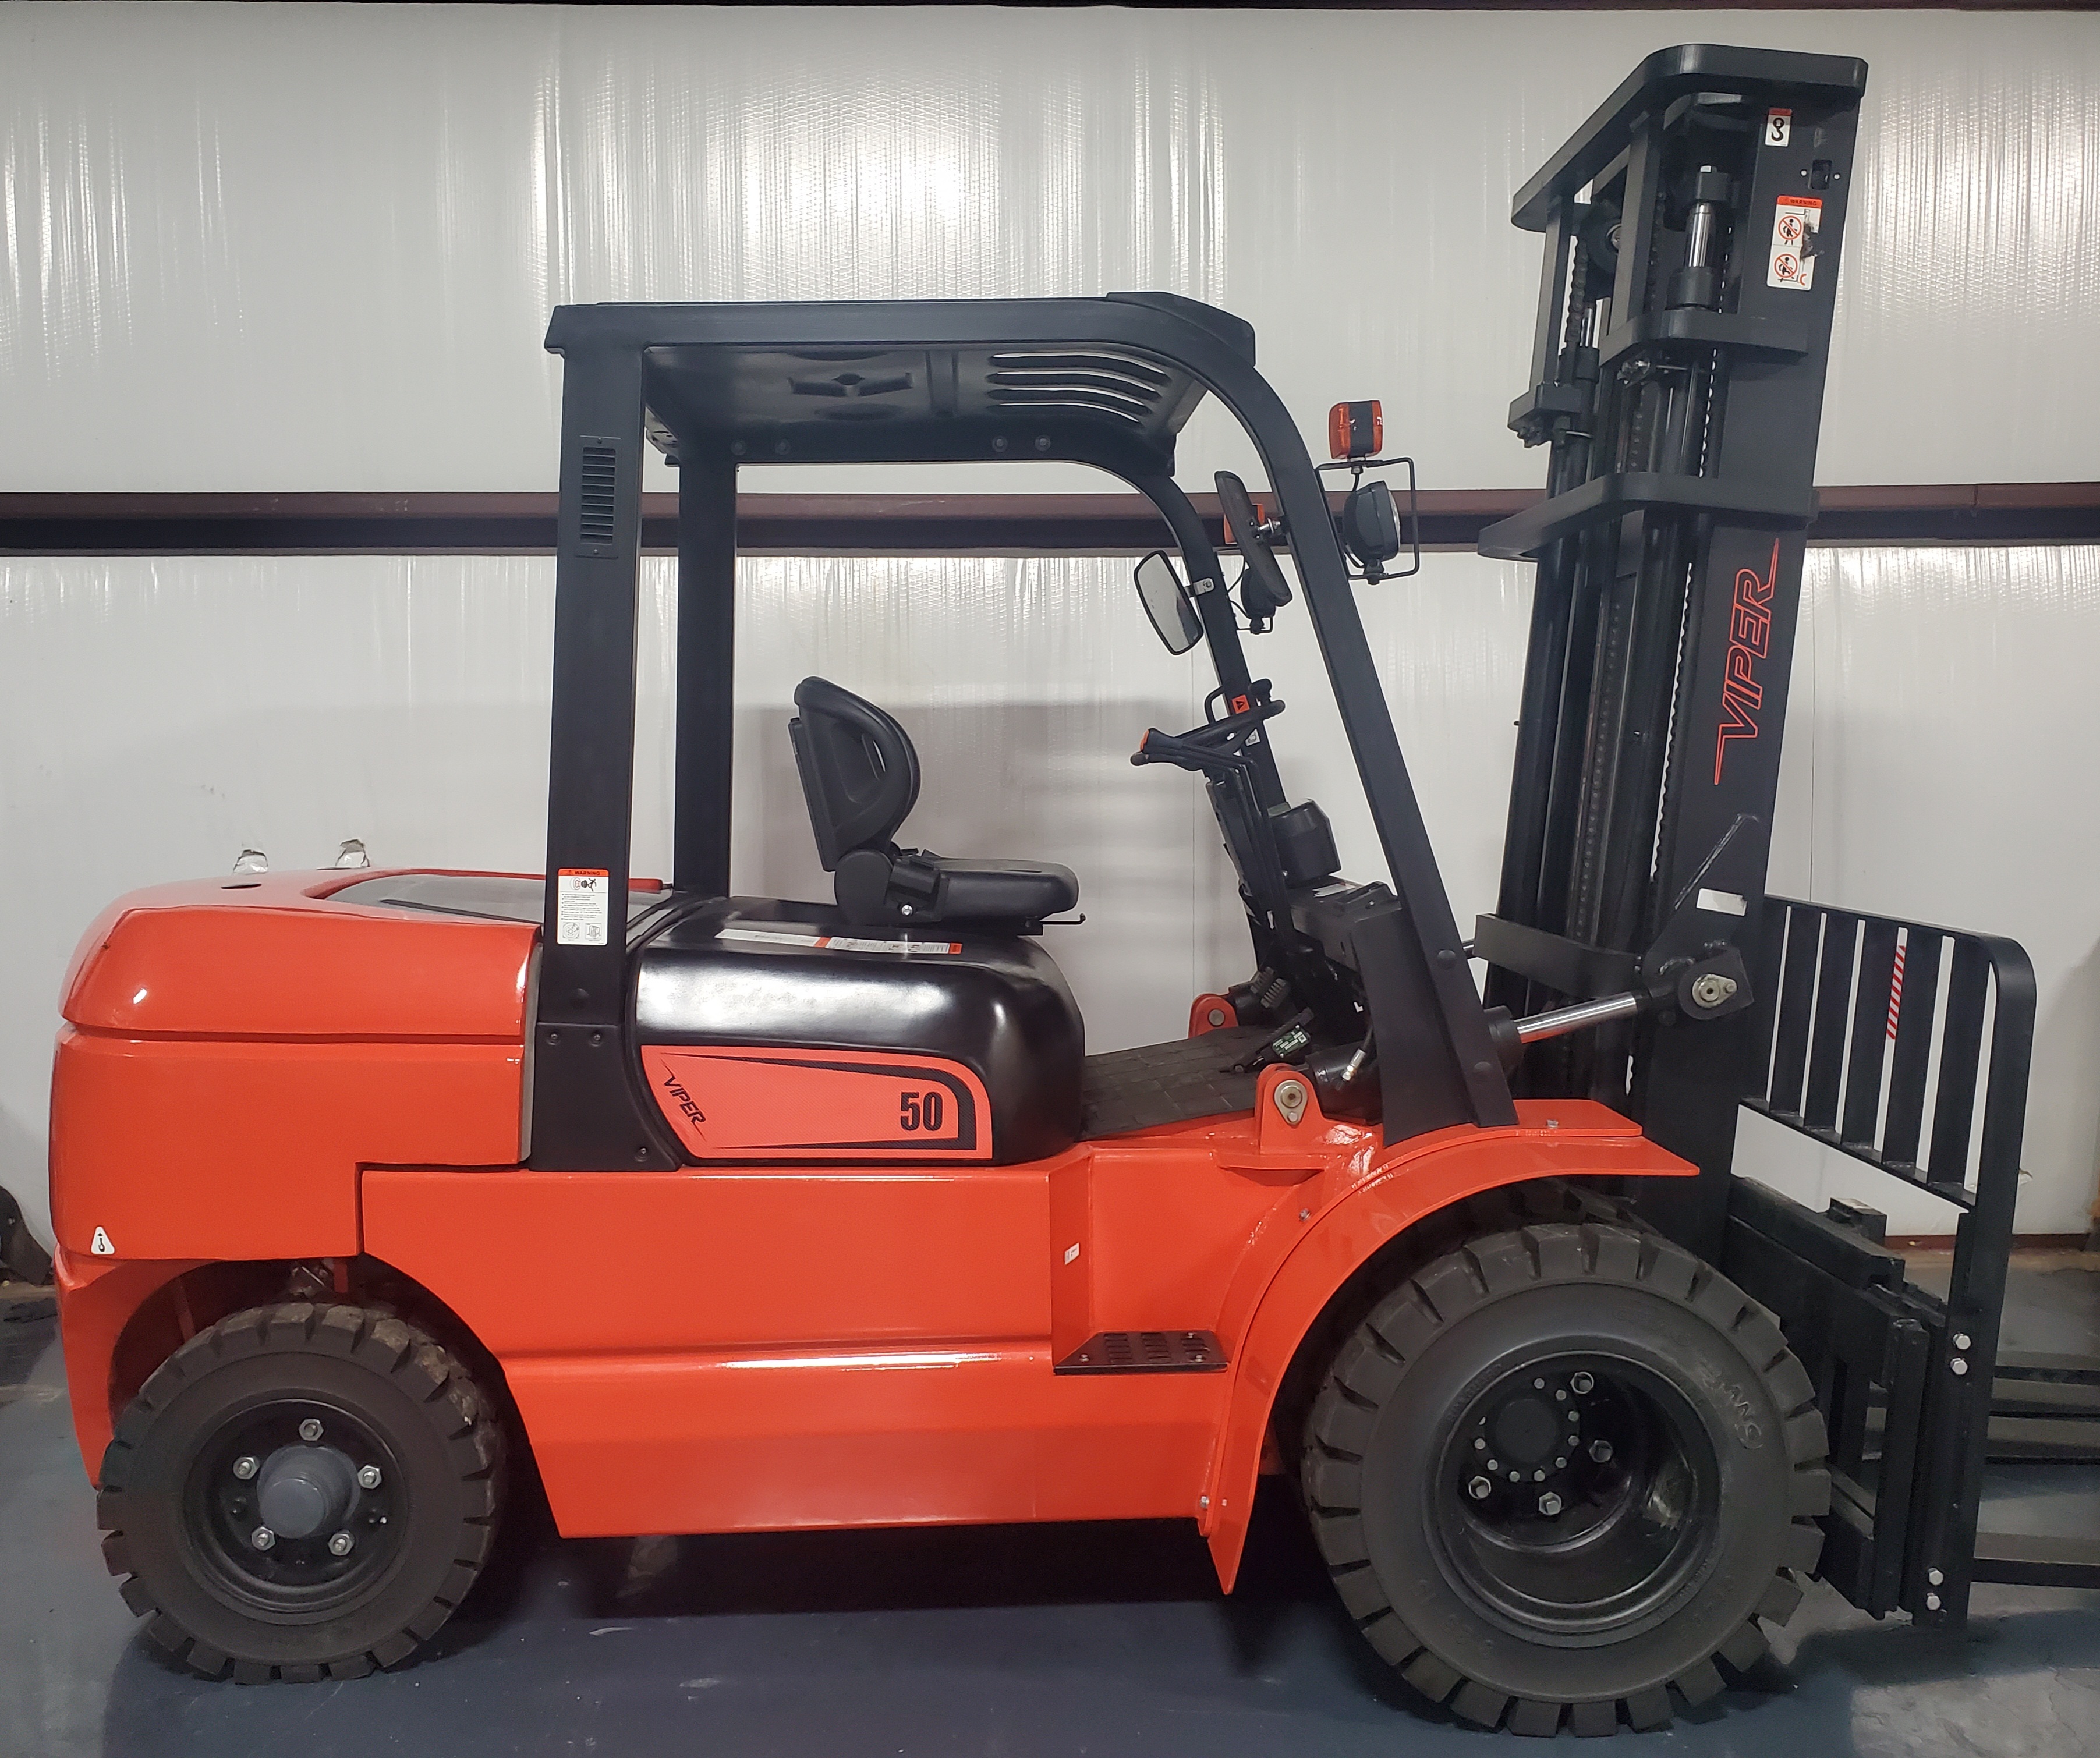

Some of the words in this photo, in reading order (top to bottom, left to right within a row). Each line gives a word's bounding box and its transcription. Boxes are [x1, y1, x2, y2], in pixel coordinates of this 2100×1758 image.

[1714, 539, 1779, 785] VIPER
[659, 1058, 707, 1142] VIPER
[900, 1091, 943, 1131] 50
